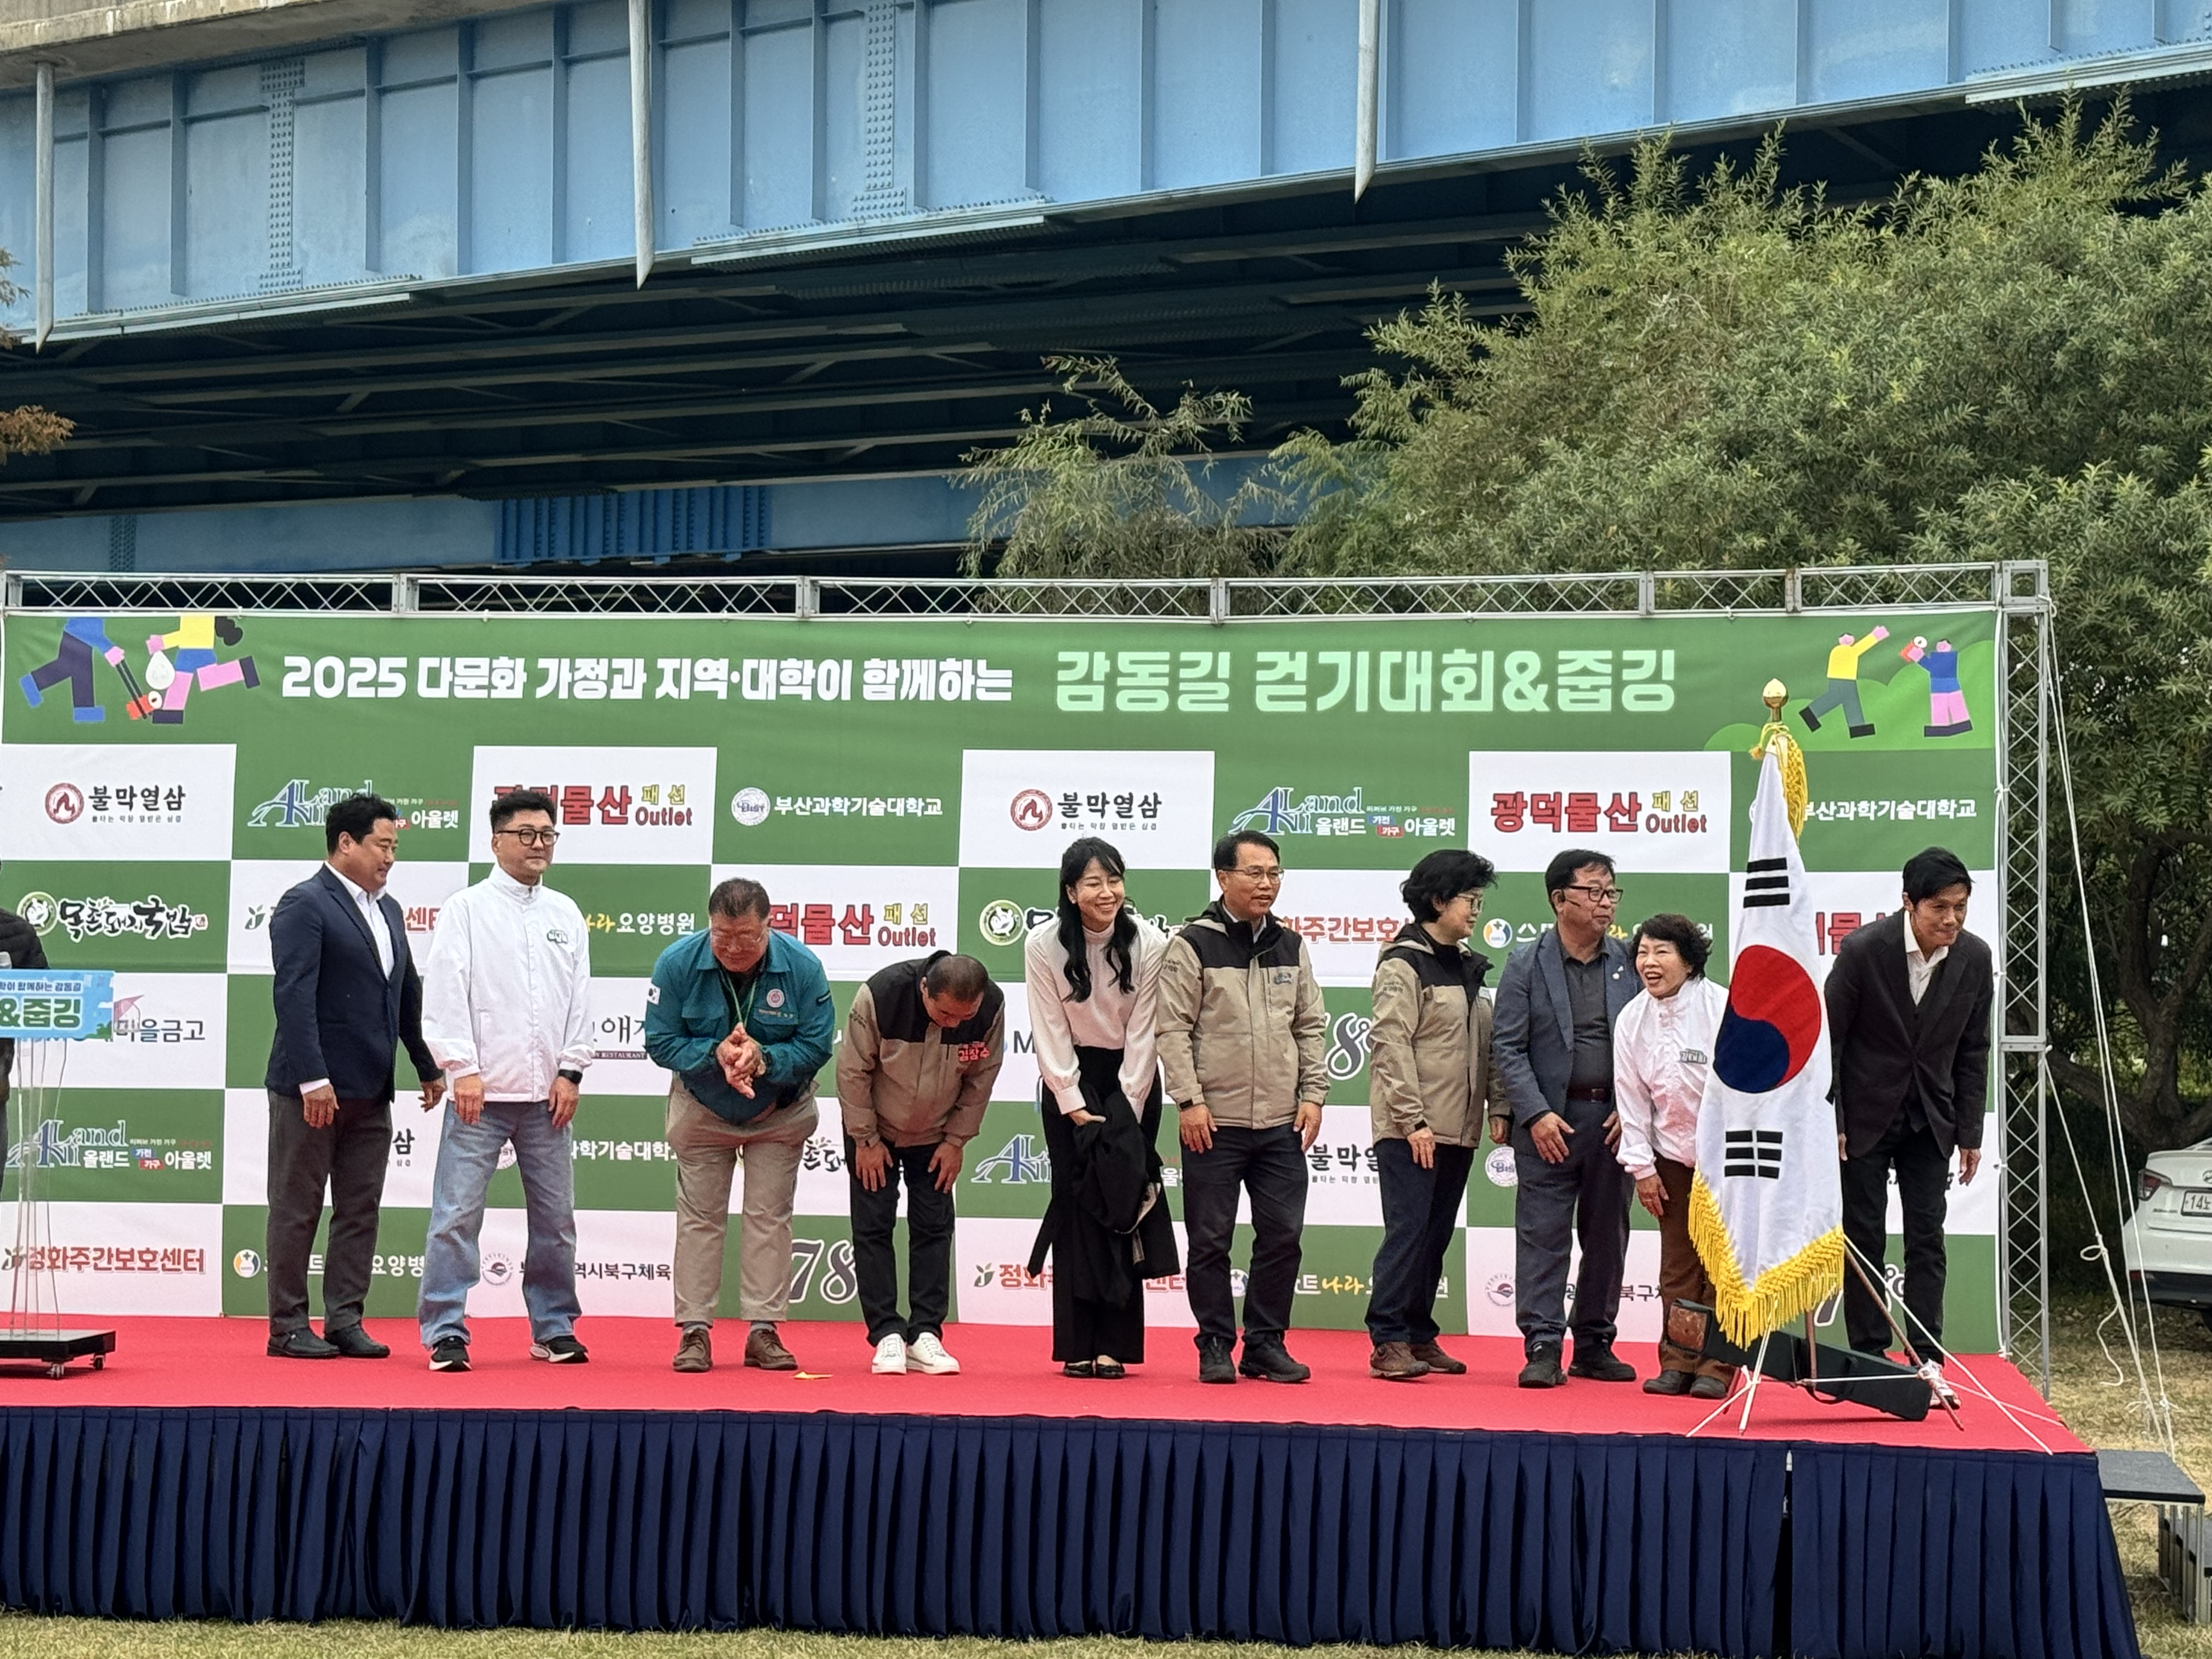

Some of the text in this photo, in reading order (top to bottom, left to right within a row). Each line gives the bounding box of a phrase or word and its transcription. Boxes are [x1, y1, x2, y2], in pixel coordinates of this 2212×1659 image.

[282, 648, 1675, 713] 2025 다문화 가정과 지역·대학이 함께하는 감동길 걷기대회&줍깅
[89, 785, 187, 811] 불막열삼
[774, 797, 943, 816] 부산과학기술대학교
[1057, 792, 1162, 819] 불막열삼
[411, 809, 459, 829] 아울렛
[635, 806, 693, 826] Outlet
[1491, 792, 1642, 833] 광덕물산
[1645, 813, 1707, 833] Outlet
[1316, 817, 1455, 837] 올랜드 아울렛
[769, 902, 874, 945] 덕물산
[878, 926, 936, 947] Outlet
[116, 1018, 205, 1043] 마을금고
[83, 1150, 212, 1170] 올랜드 아울렛
[29, 1246, 205, 1273] 정화주간보호센터
